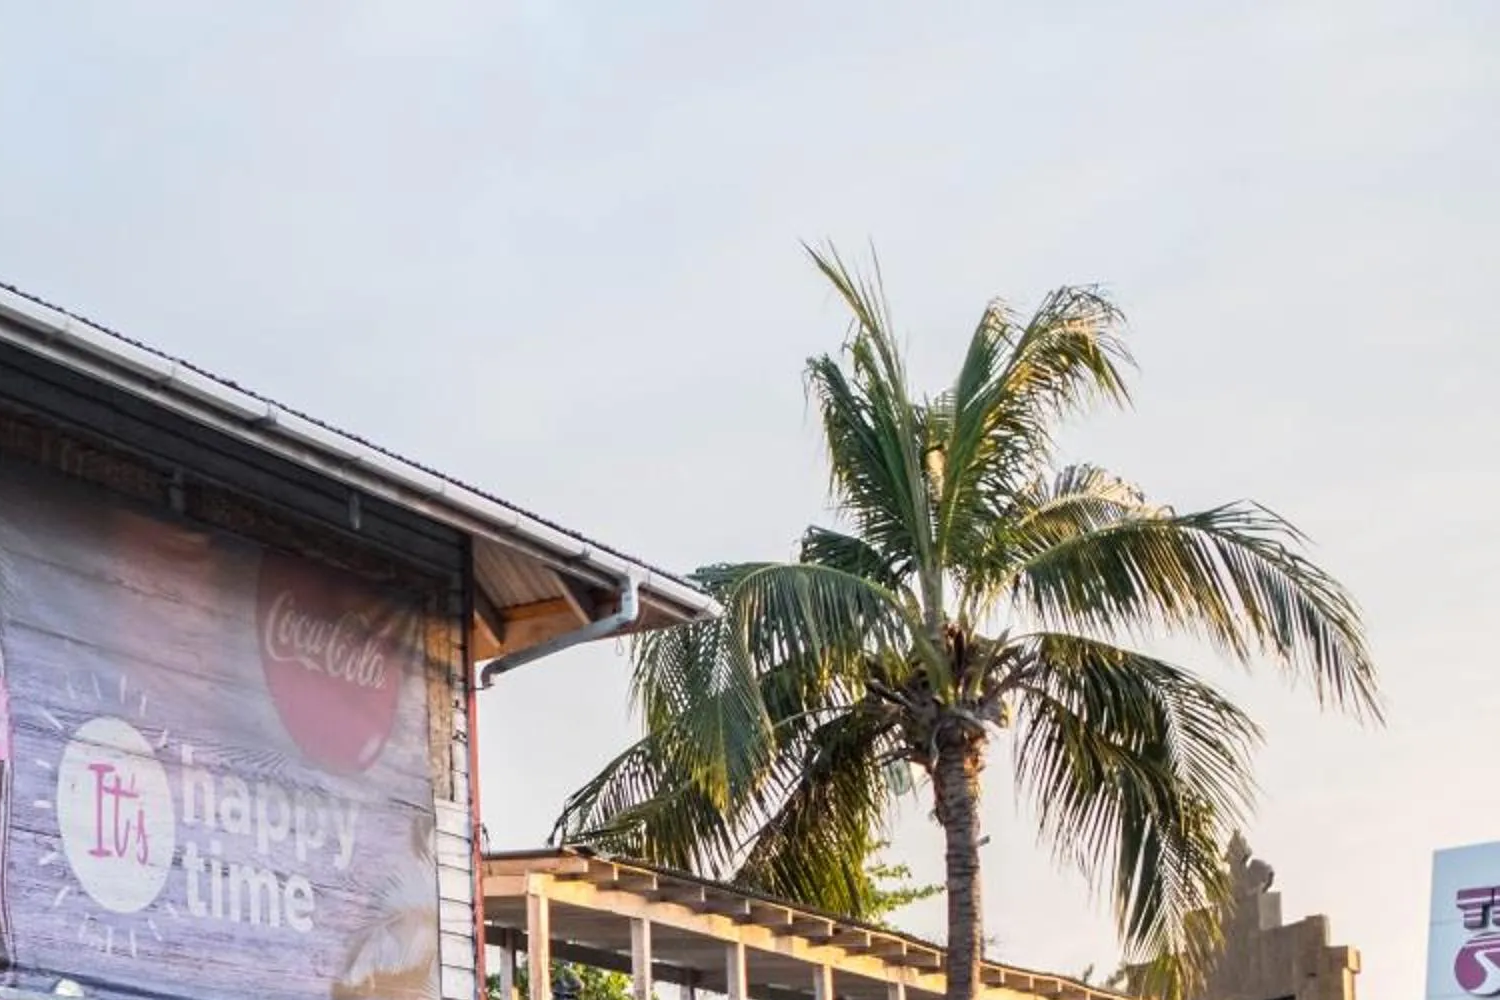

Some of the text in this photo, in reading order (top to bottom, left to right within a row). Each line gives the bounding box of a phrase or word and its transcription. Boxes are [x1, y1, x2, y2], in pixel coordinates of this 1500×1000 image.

[266, 590, 387, 689] Coca-Cola
[88, 763, 150, 866] It's
[181, 745, 358, 871] happy
[183, 841, 315, 933] time
